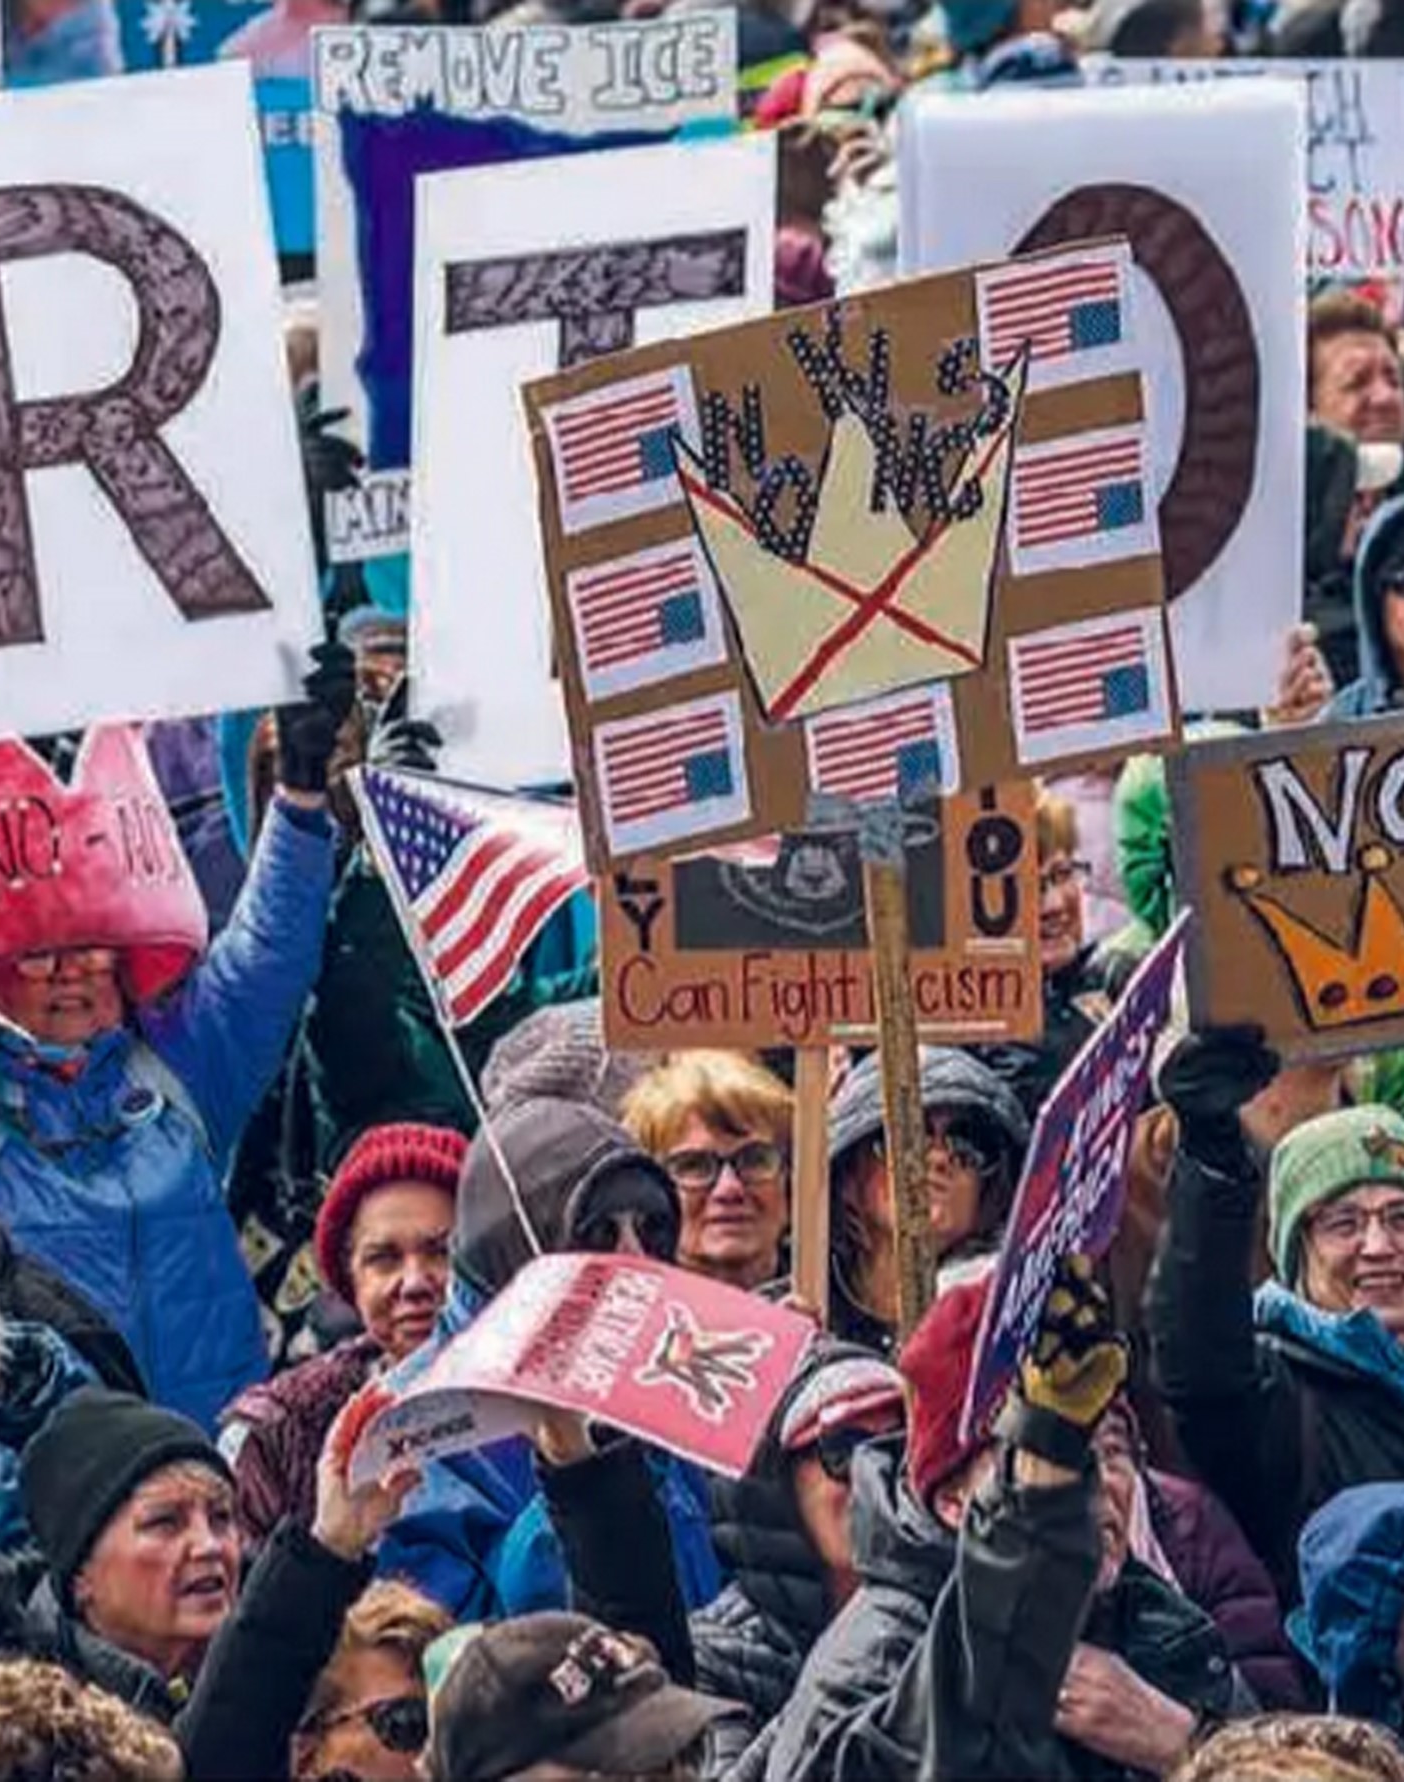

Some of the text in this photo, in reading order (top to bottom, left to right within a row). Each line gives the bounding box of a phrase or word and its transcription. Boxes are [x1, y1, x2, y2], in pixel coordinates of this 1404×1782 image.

[319, 22, 719, 116] REMOVE ICE
[618, 957, 730, 1027] Can
[738, 952, 857, 1040] Fight
